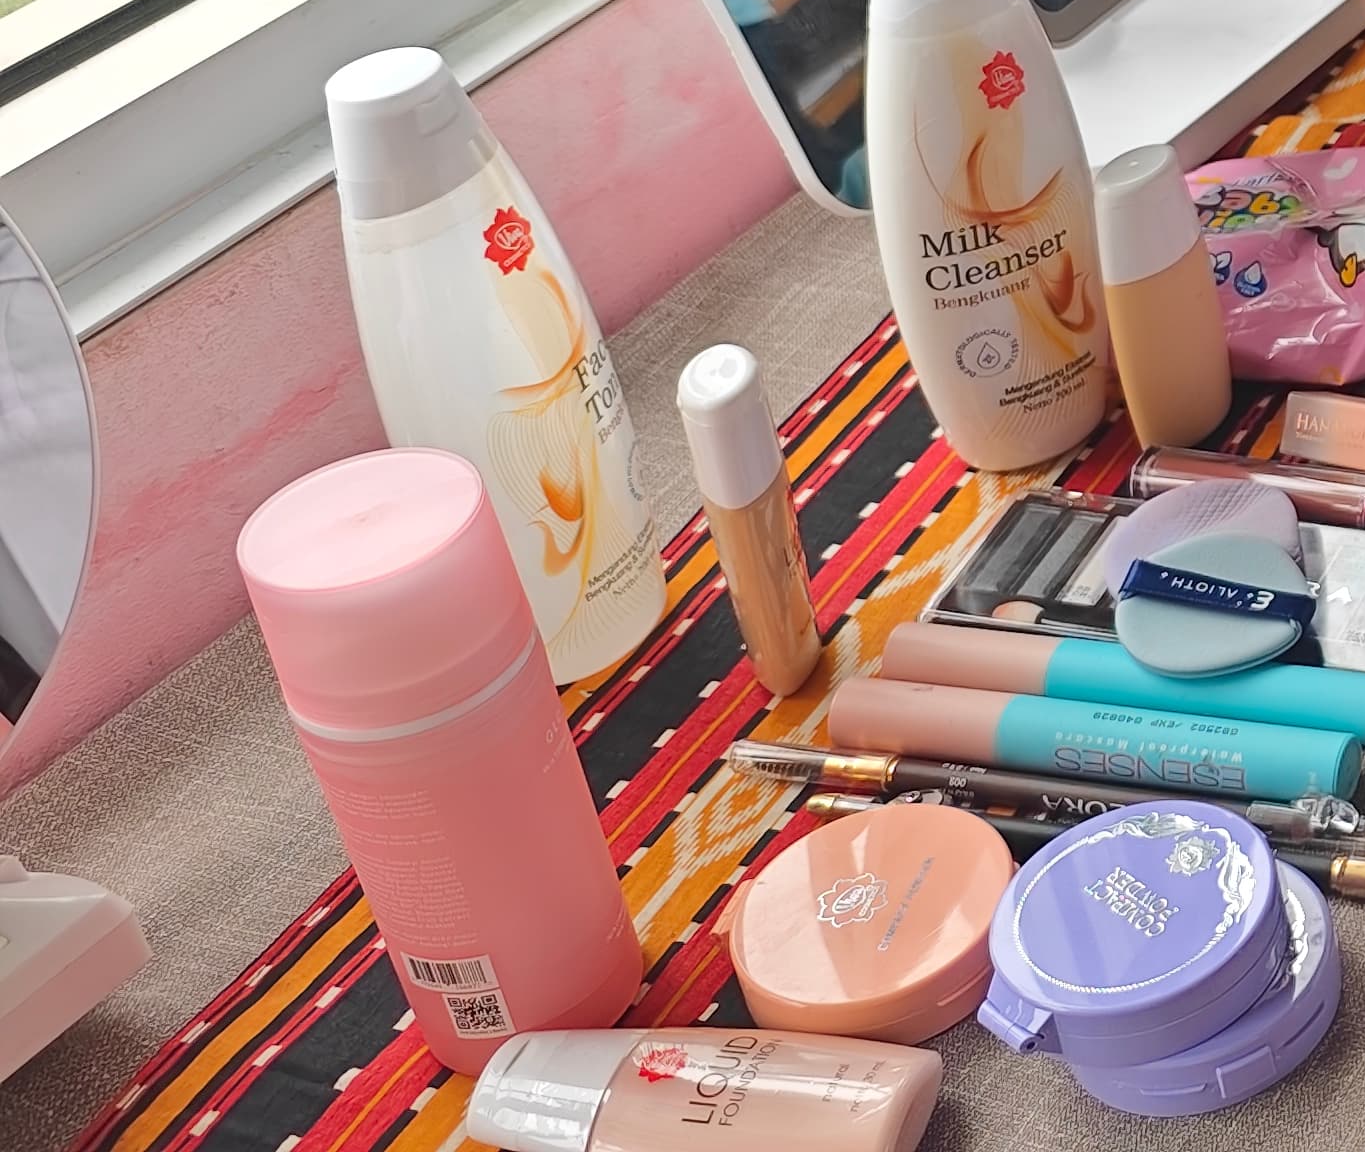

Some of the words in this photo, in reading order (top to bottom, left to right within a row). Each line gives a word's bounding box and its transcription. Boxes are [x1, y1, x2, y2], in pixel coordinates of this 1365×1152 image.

[919, 222, 1007, 258] Milk
[925, 229, 1067, 291] Cleanser
[933, 277, 1031, 310] Bengkuang
[1170, 576, 1239, 599] ALIOTH
[1054, 730, 1129, 751] Mascara
[1054, 747, 1247, 792] ESENSES
[1083, 878, 1166, 938] COMPACT
[681, 1035, 759, 1125] LIQUID
[718, 1038, 783, 1127] FOUNDATION
